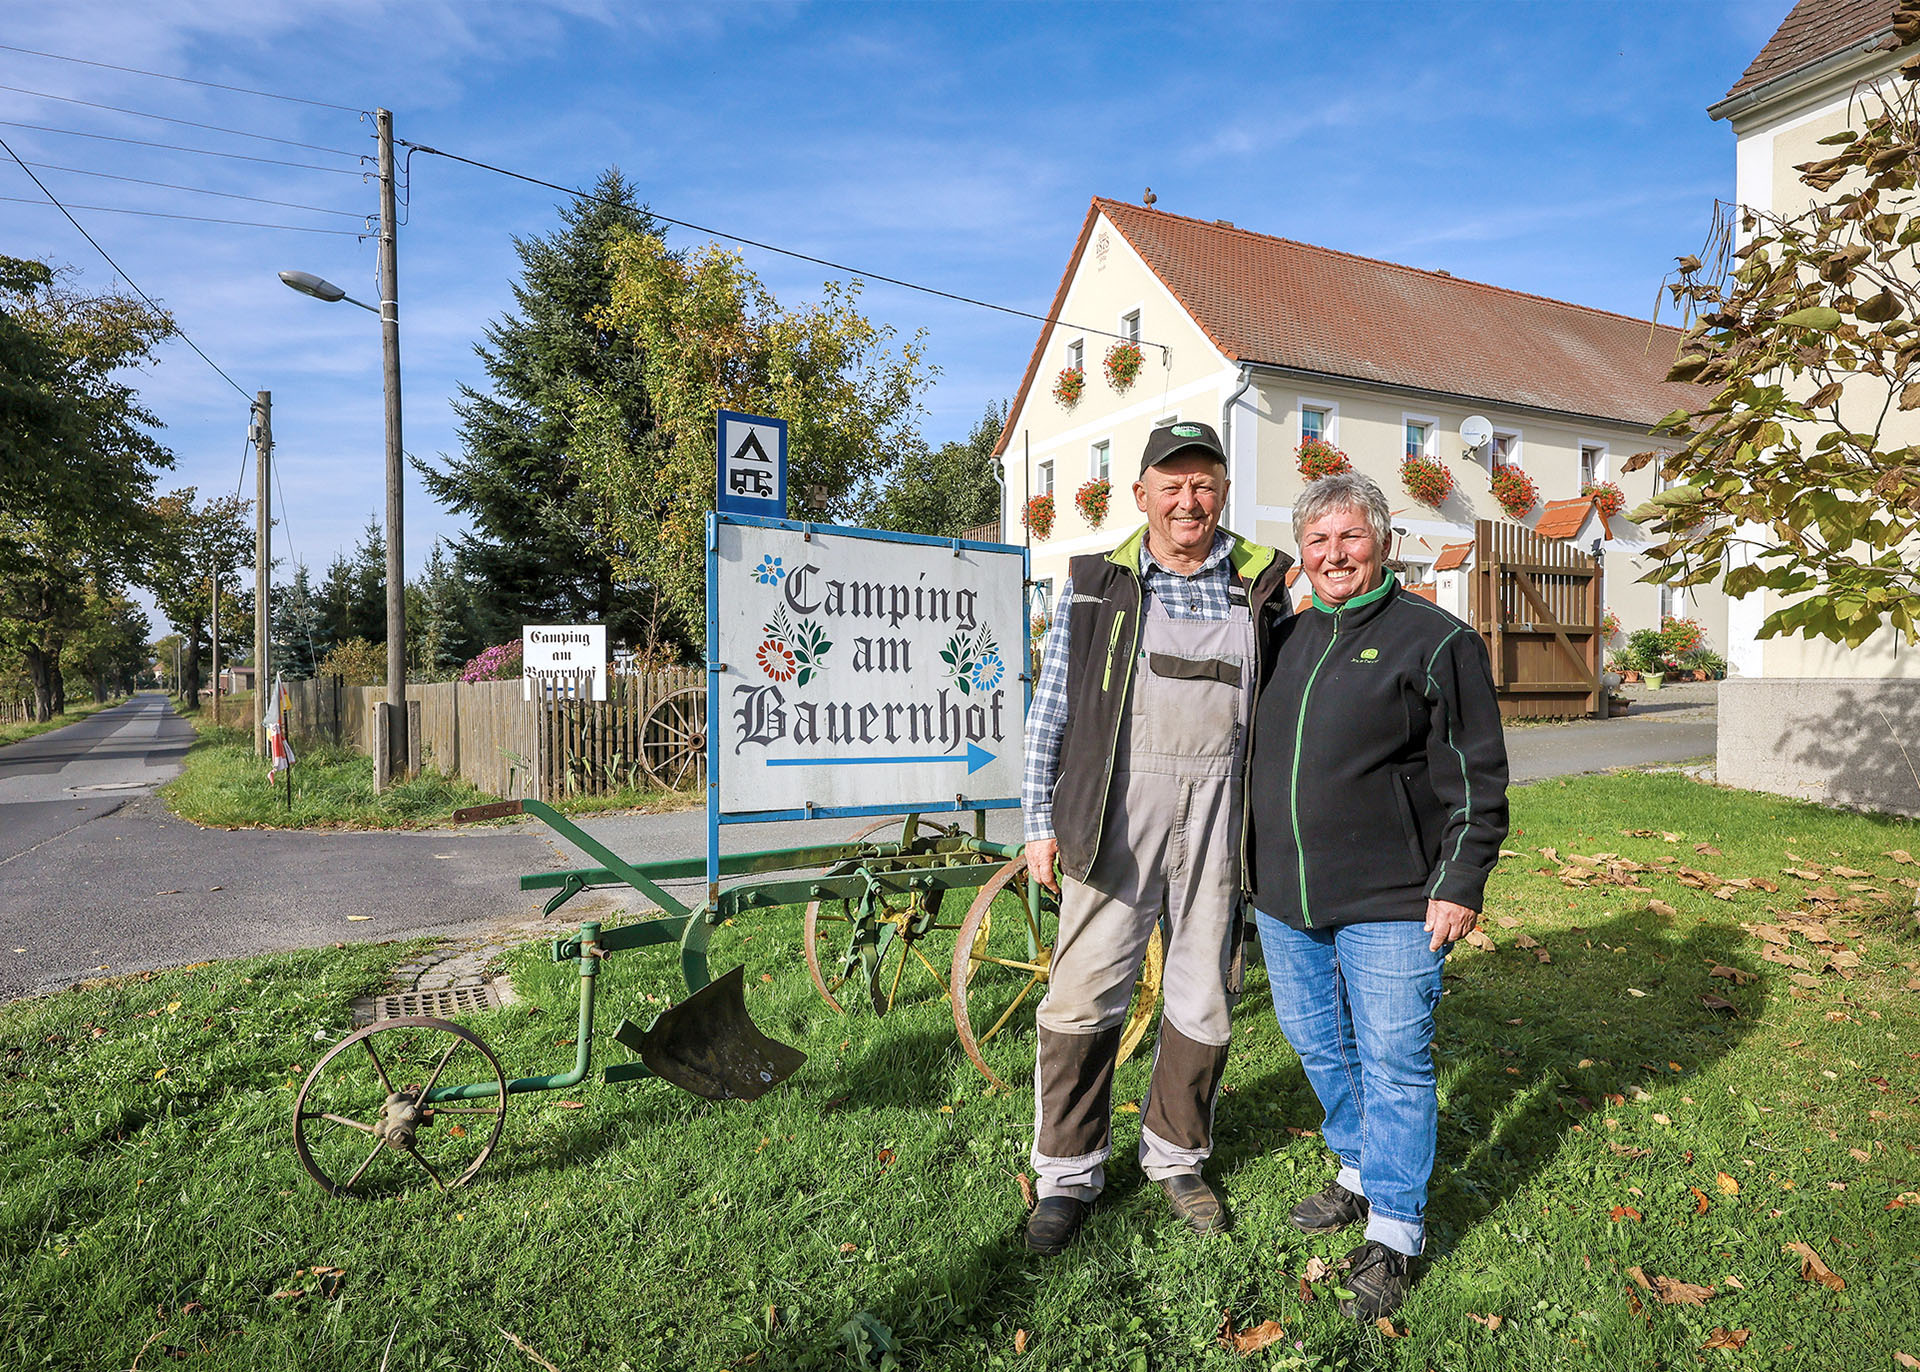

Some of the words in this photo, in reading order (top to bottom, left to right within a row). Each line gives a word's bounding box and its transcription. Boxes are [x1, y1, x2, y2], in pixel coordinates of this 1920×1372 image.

[784, 563, 978, 631] Camping
[530, 631, 591, 646] Camping
[552, 651, 572, 661] am
[852, 636, 912, 674] am
[524, 666, 597, 680] Bauernhof
[733, 684, 1006, 755] Bauernhof
